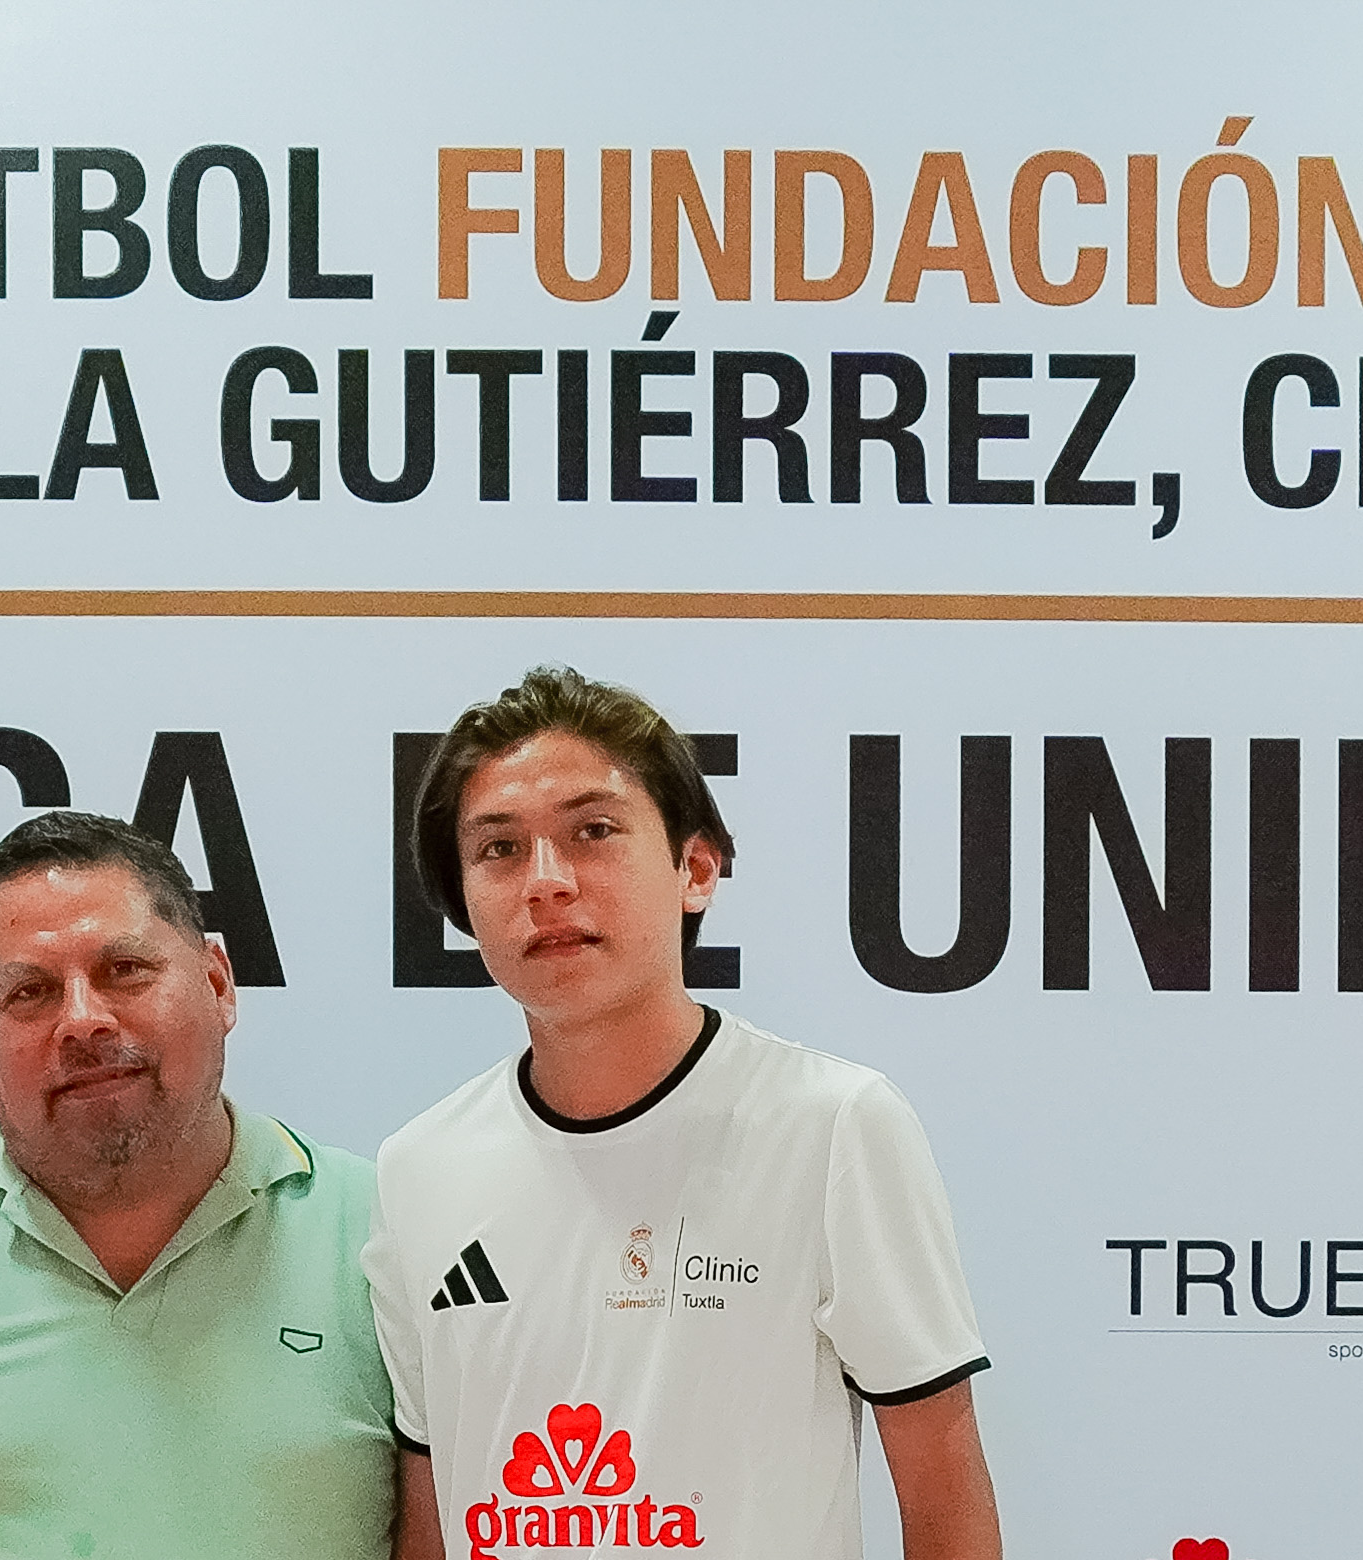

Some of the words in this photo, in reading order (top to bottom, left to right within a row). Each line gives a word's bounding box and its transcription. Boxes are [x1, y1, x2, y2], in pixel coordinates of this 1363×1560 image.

[221, 311, 1180, 540] GUTIÉRREZ,
[686, 1256, 759, 1283] Clinic
[683, 1294, 724, 1309] Tuxtla
